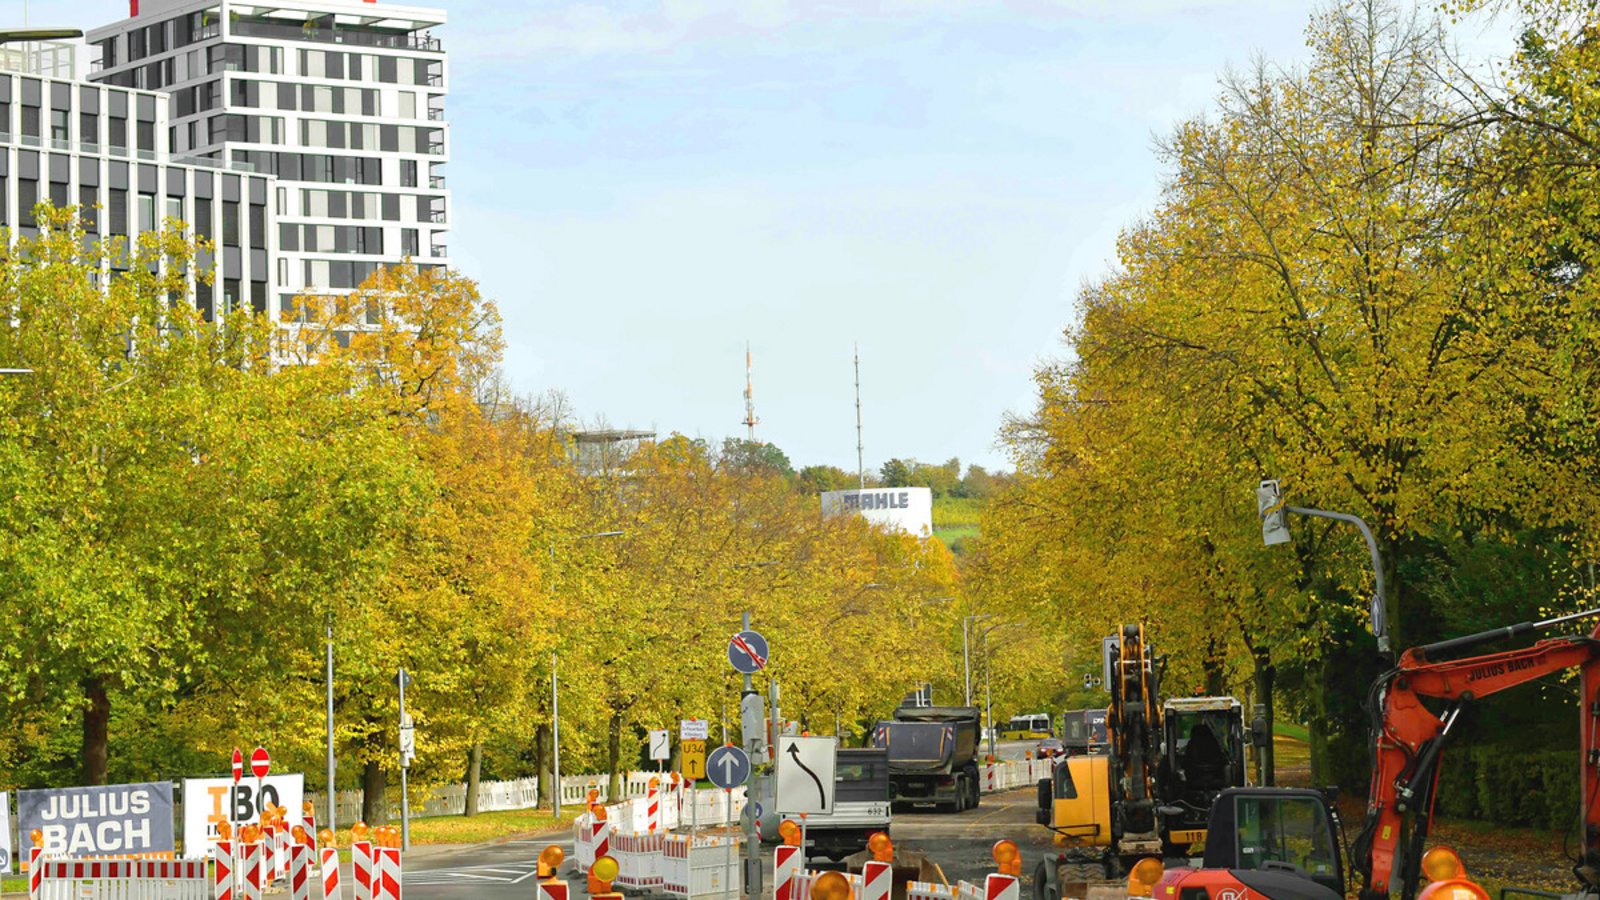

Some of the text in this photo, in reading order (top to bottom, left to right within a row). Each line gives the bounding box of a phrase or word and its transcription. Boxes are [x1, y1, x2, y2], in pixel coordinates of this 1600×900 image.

[843, 492, 909, 511] MAHLE
[1470, 663, 1505, 681] JULIUS
[1507, 657, 1535, 673] BACH
[683, 743, 704, 754] U34
[41, 790, 150, 821] JULIUS
[207, 784, 280, 823] IBO
[41, 818, 151, 855] BACH
[1186, 831, 1202, 841] 118
